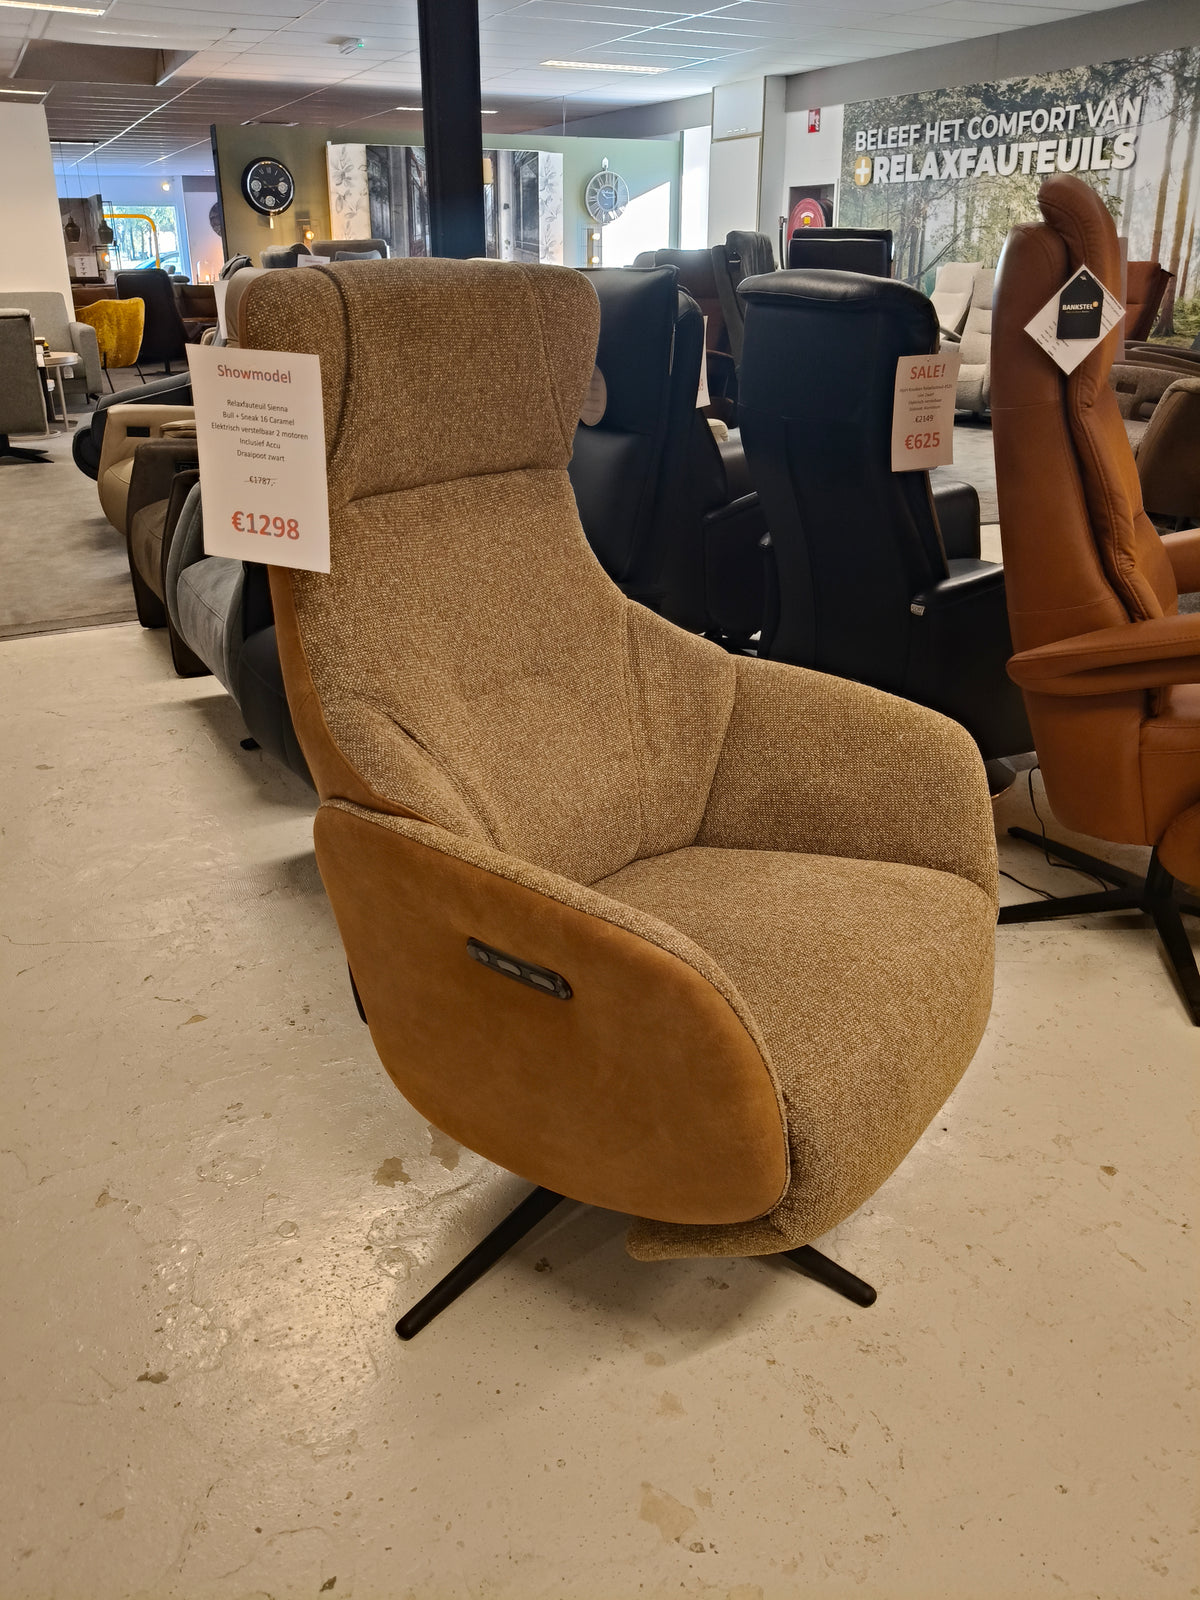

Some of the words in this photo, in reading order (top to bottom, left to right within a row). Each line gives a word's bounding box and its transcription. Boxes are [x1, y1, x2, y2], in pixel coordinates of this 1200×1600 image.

[855, 124, 921, 151] BELEEF
[925, 119, 965, 145] HET
[967, 104, 1082, 140] COMFORT
[1086, 96, 1143, 126] VAN
[873, 133, 1139, 185] RELAXFAUTEUILS
[1062, 303, 1094, 311] BANKSTEL
[217, 364, 292, 384] Showmodel
[910, 363, 946, 380] SALE!
[226, 399, 266, 411] Relaxfauteuil
[267, 403, 288, 413] Sienna
[222, 411, 235, 419] Bull
[260, 415, 268, 423] 16
[269, 416, 295, 426] Caramel
[211, 422, 240, 432] Elektrisch
[241, 427, 275, 436] verstelbaar
[276, 429, 280, 437] 2
[281, 431, 309, 440] motoren
[239, 438, 265, 447] Inclusief
[266, 441, 281, 449] Accu
[904, 432, 940, 451] €625
[236, 449, 267, 460] Draaipoot
[231, 510, 300, 541] €1298
